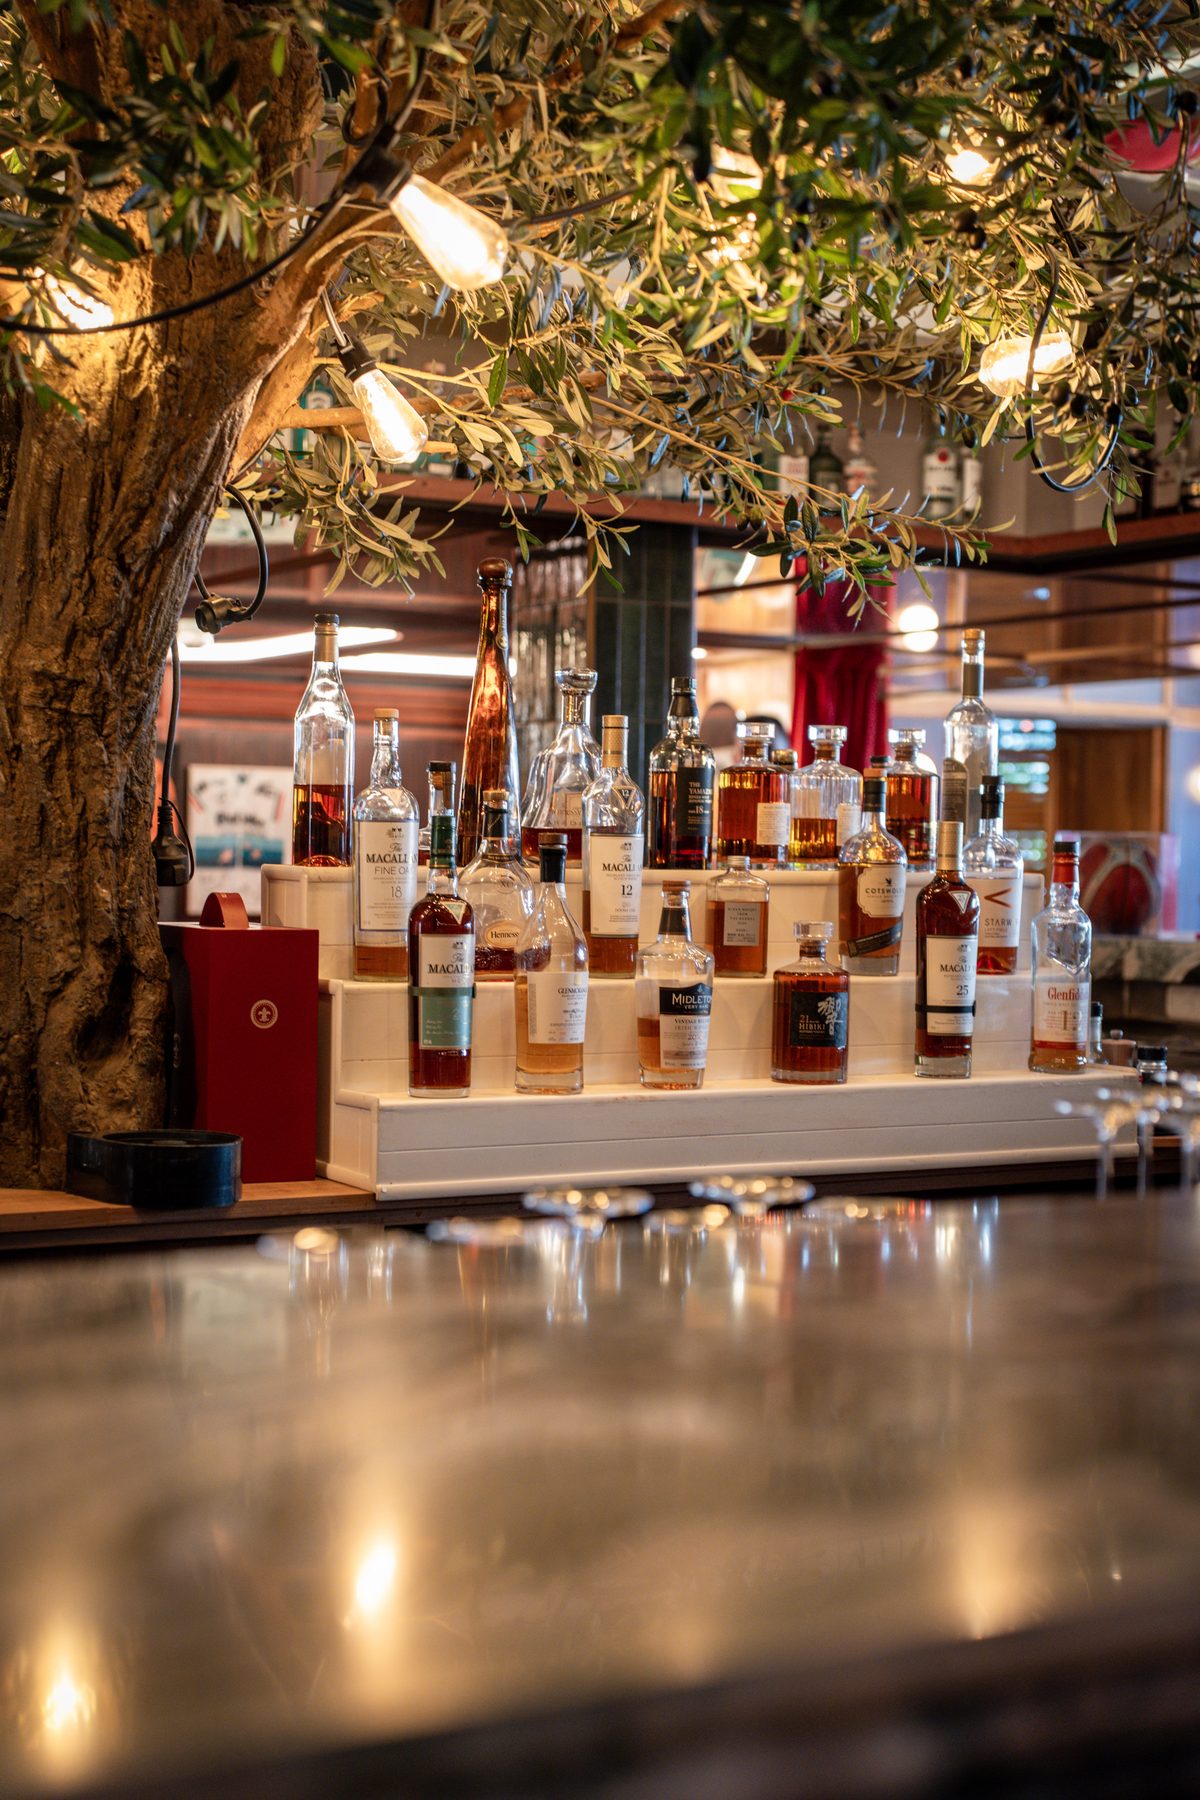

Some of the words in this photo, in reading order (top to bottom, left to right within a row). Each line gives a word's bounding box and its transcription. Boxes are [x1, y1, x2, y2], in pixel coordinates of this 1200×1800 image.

[695, 805, 704, 814] 18
[366, 853, 418, 864] MACALLN
[374, 866, 397, 876] FINE
[391, 885, 402, 898] 18
[621, 884, 633, 896] 12
[984, 918, 1014, 927] STARW
[956, 985, 969, 996] 25
[799, 1014, 809, 1023] 21
